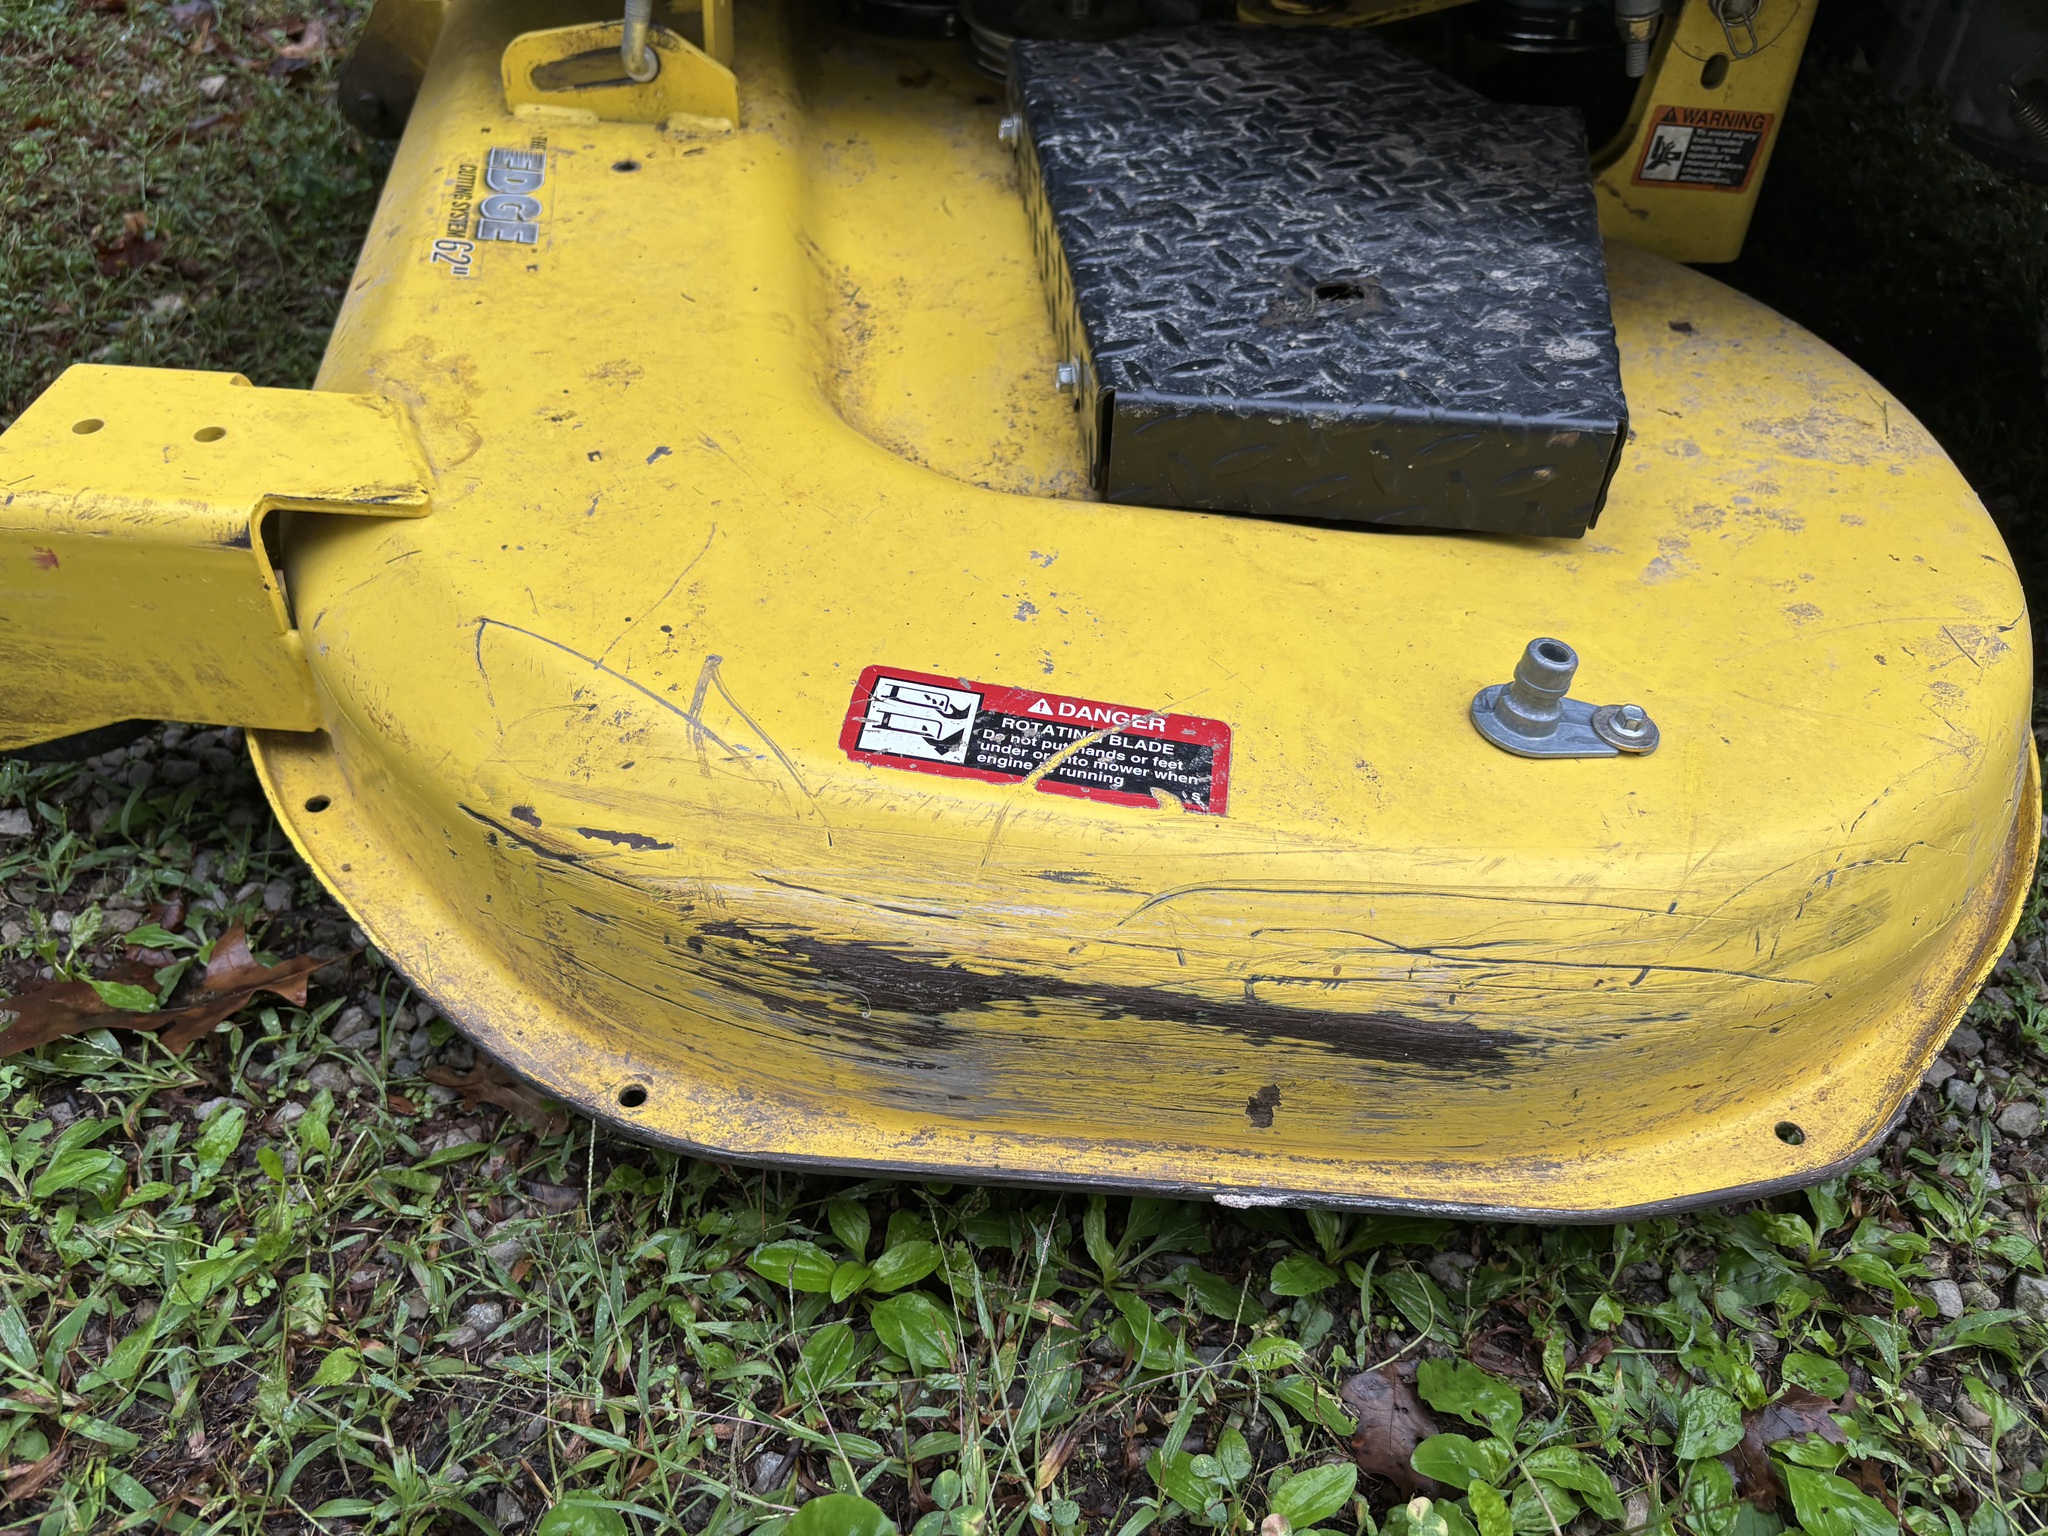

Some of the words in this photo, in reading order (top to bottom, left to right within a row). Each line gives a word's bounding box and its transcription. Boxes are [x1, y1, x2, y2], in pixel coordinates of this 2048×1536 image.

[1682, 108, 1766, 130] WARNING
[452, 163, 477, 201] CUTTING
[476, 146, 547, 244] EDGE
[446, 200, 471, 238] SYSTEM
[432, 238, 475, 275] 62"
[1058, 702, 1166, 733] DANGER
[980, 742, 1029, 757] under
[1032, 751, 1051, 760] or
[1060, 755, 1089, 767] nto
[1093, 760, 1150, 777] mower
[1154, 770, 1198, 785] when
[1010, 733, 1037, 747] not
[1130, 755, 1148, 765] or
[1152, 756, 1184, 771] feet
[1108, 735, 1175, 755] BLADE
[976, 753, 1033, 770] engine
[1059, 768, 1124, 787] running
